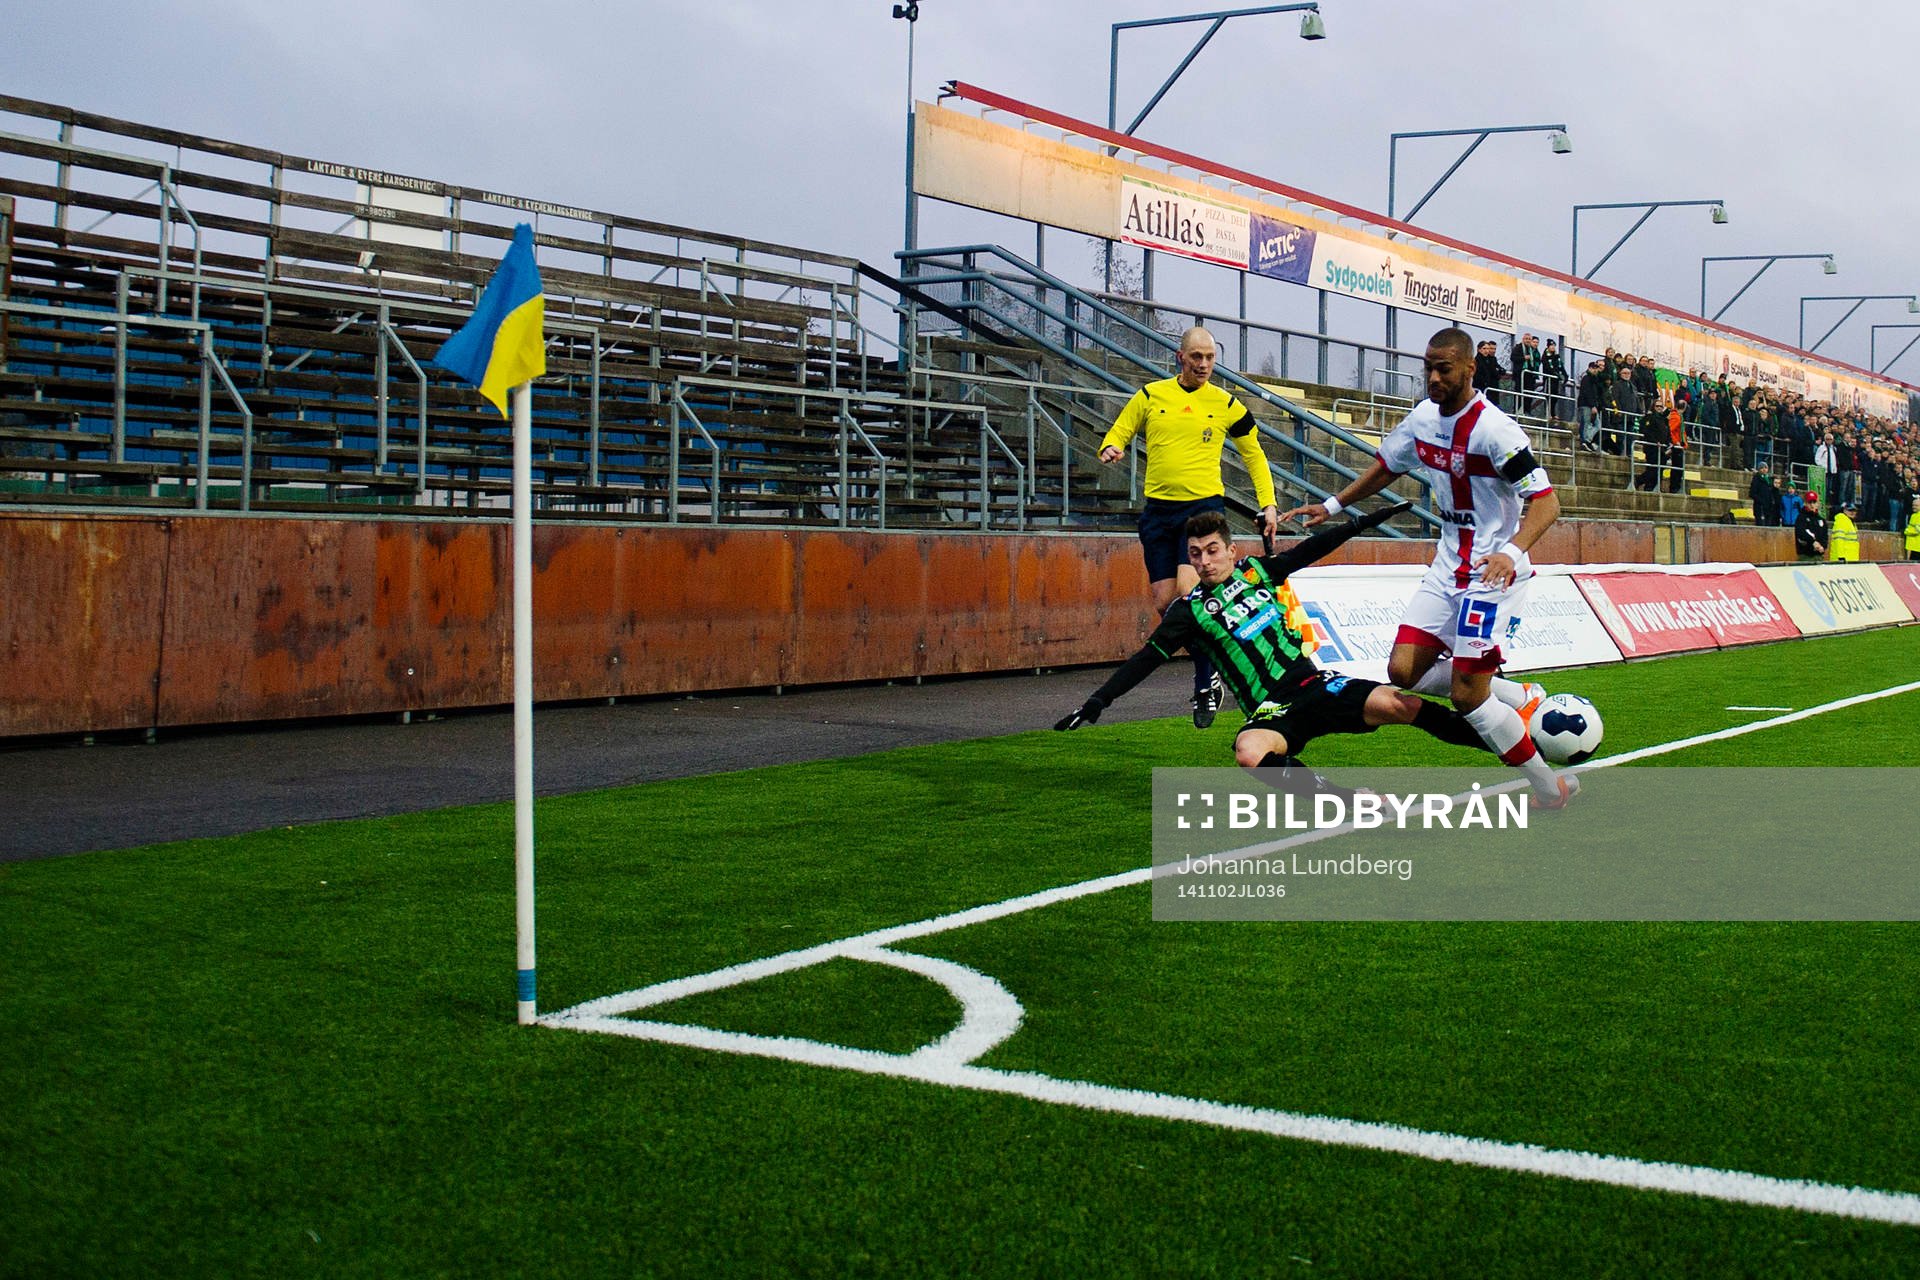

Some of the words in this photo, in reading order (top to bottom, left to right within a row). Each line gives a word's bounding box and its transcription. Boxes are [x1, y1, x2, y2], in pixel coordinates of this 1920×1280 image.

[1205, 208, 1225, 222] PIZZA
[1215, 228, 1237, 242] PASTA
[1259, 232, 1296, 262] ACTIC
[1325, 259, 1393, 298] Sydpoolen
[1403, 270, 1459, 307] Tingstad
[1466, 287, 1515, 321] Tingstad
[1221, 588, 1272, 630] ÅBRO
[1618, 588, 1782, 637] www.assyriska.se
[1819, 577, 1885, 615] POSTEN
